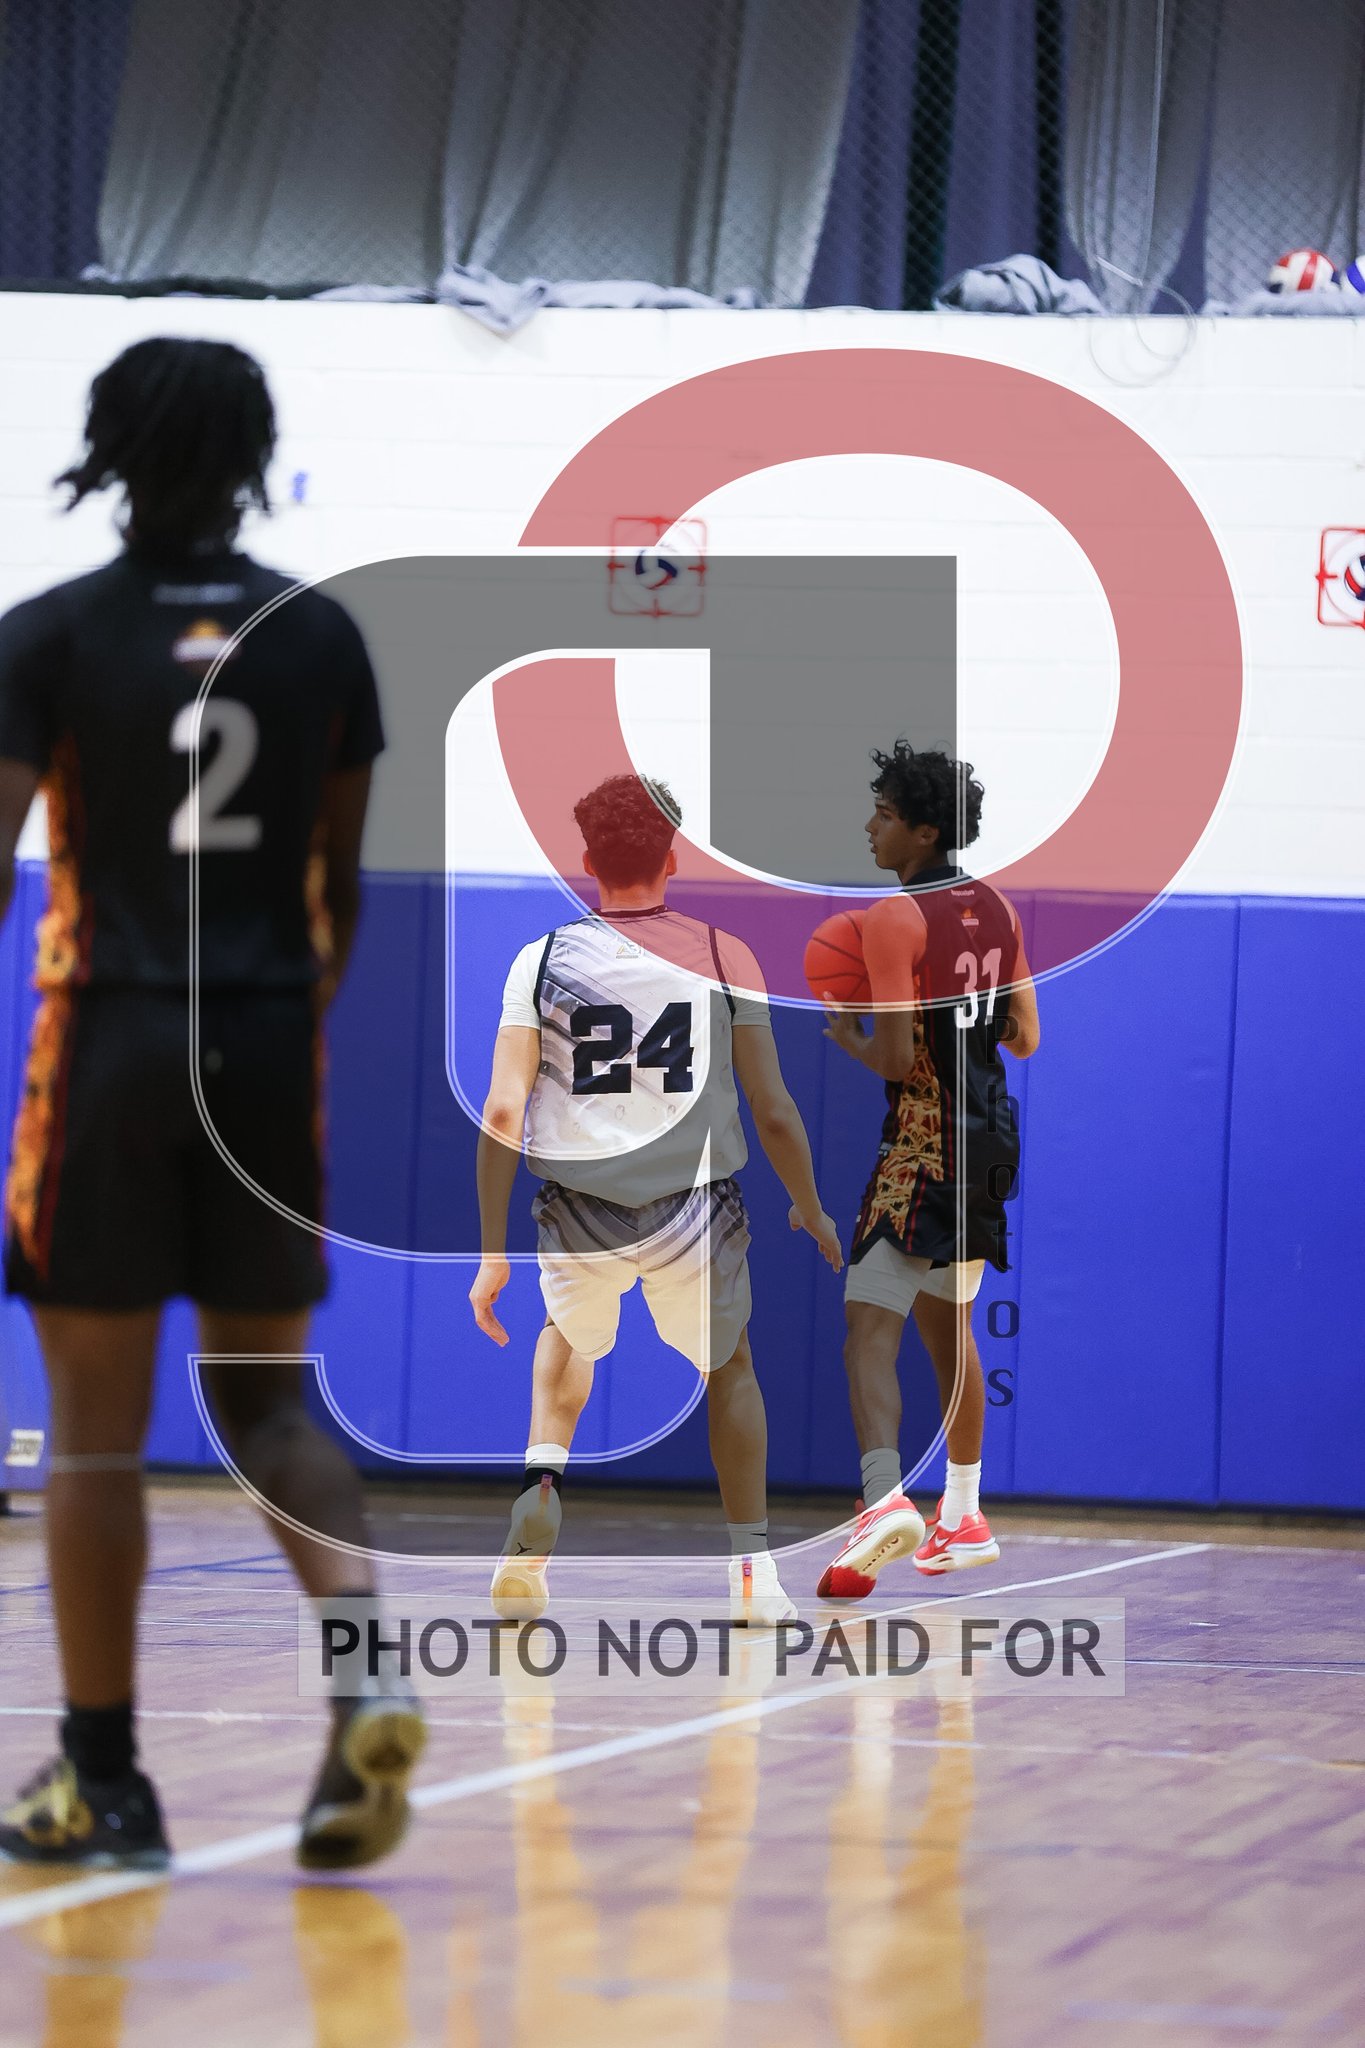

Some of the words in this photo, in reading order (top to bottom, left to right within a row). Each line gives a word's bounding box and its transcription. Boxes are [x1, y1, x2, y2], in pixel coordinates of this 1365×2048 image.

[169, 698, 263, 852] 2
[954, 947, 1002, 1030] 31
[571, 1001, 694, 1096] 24
